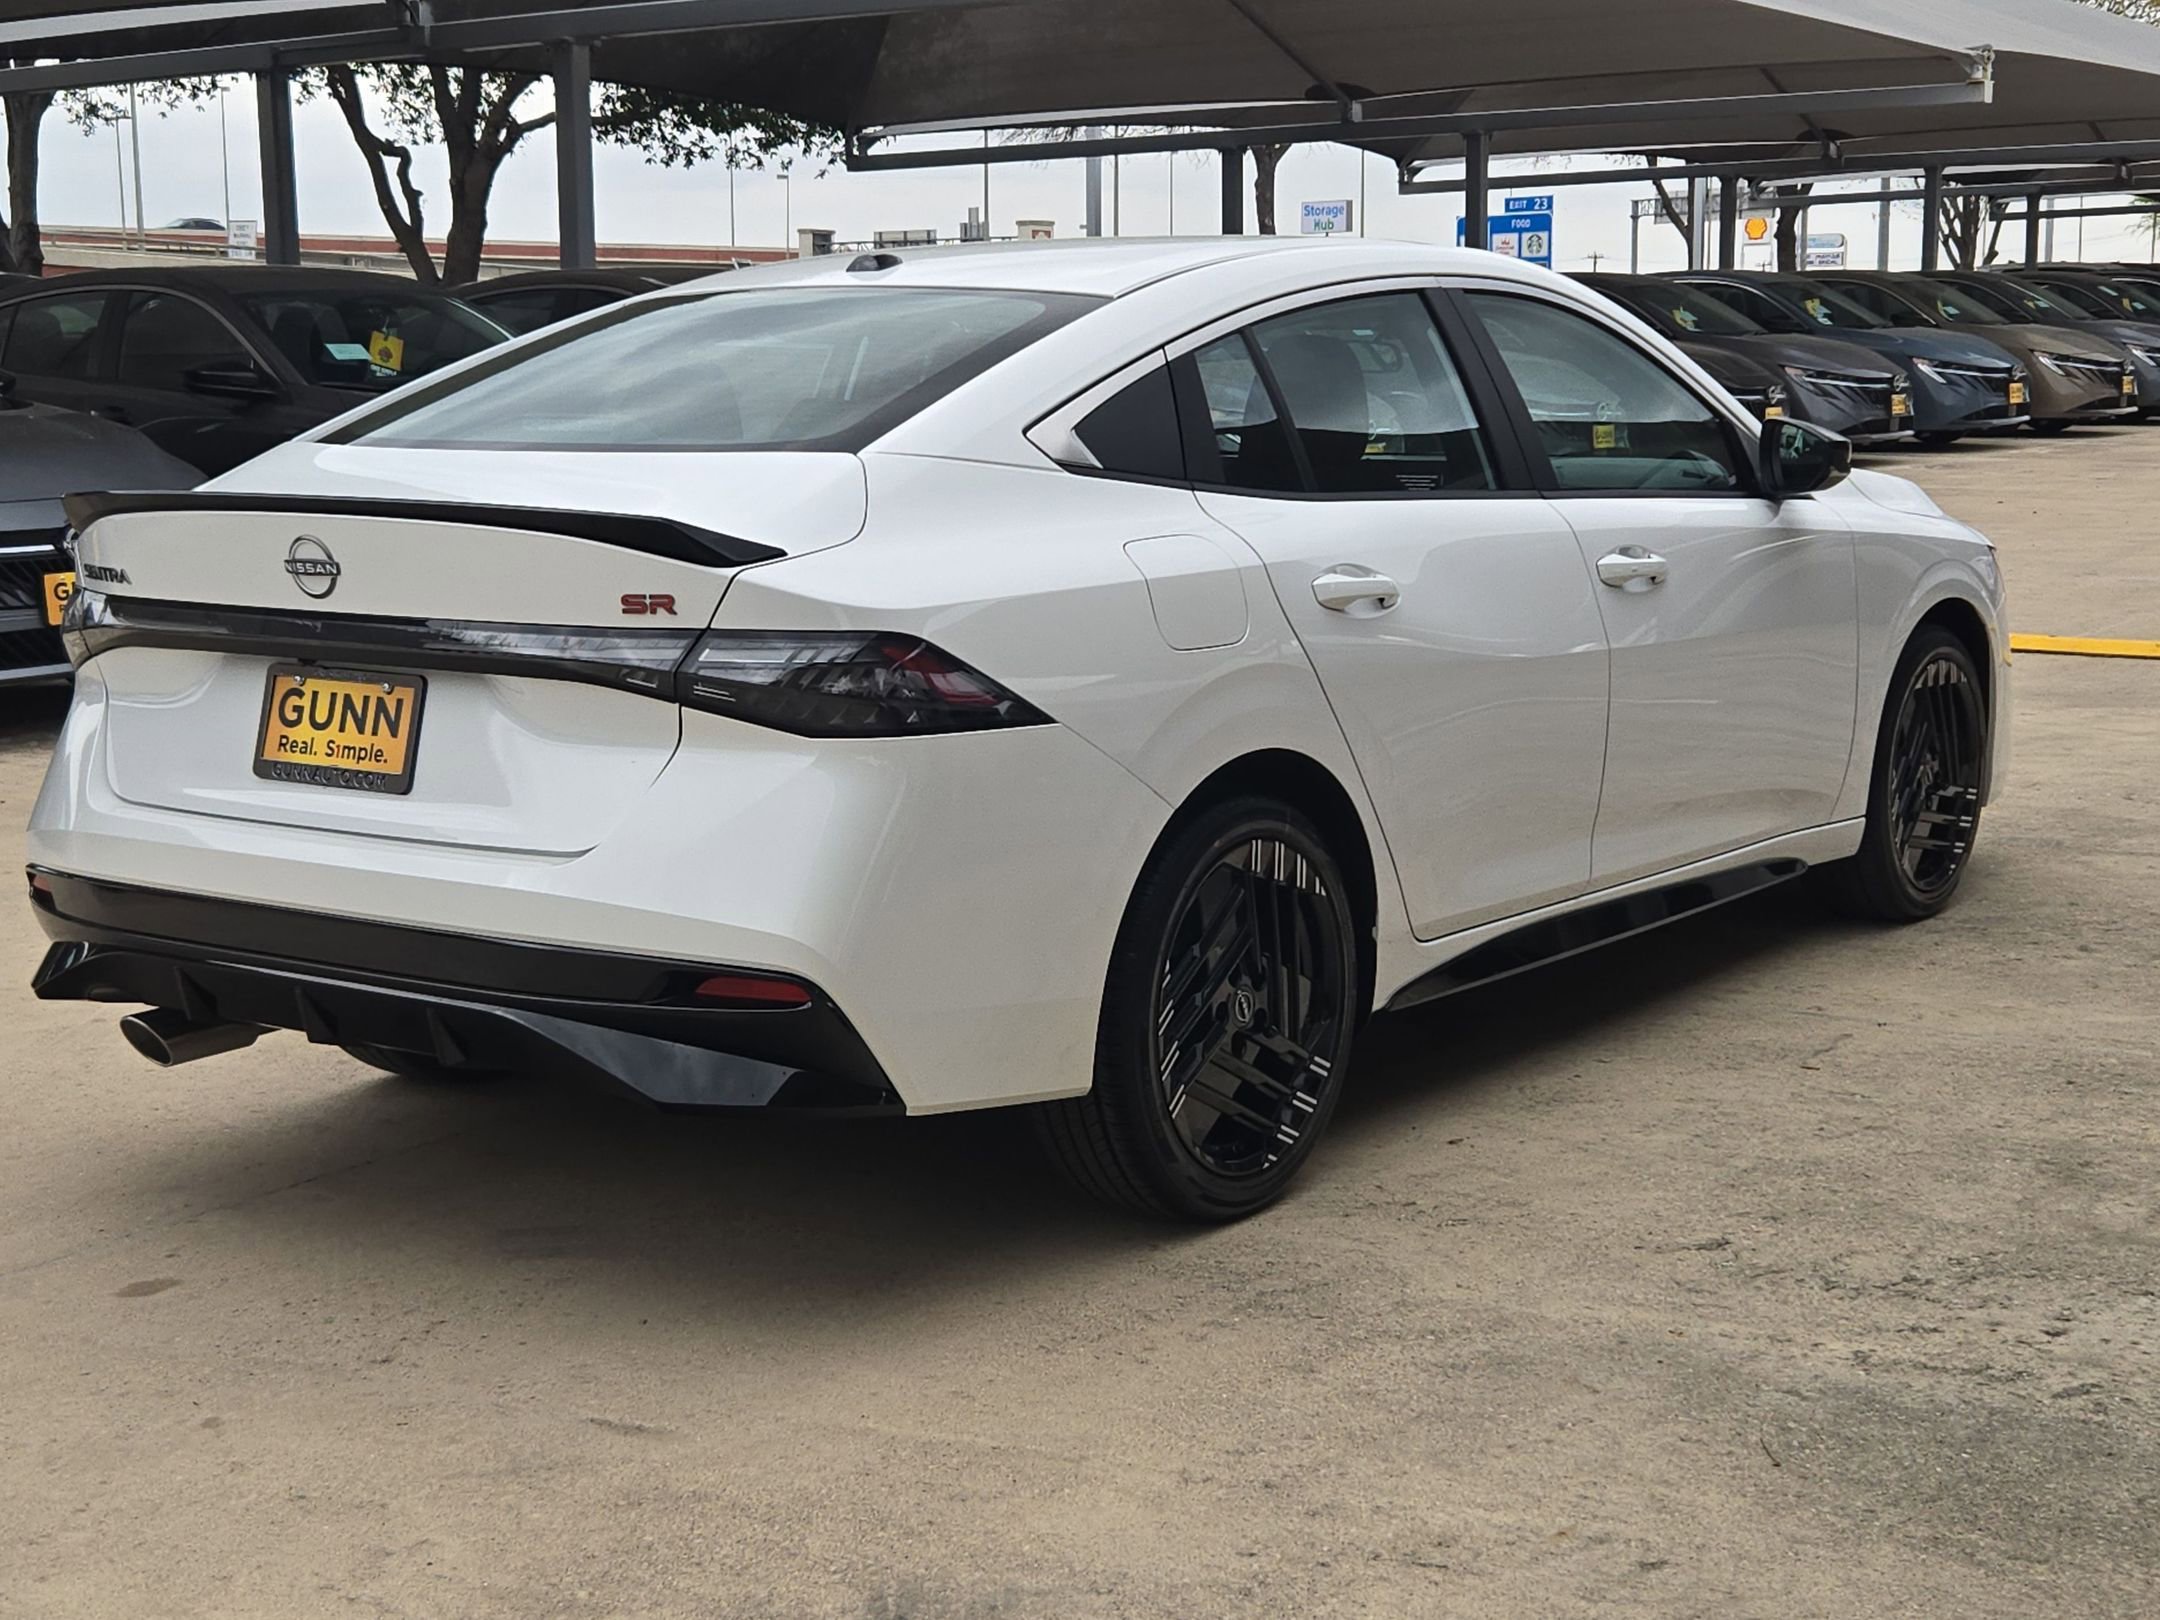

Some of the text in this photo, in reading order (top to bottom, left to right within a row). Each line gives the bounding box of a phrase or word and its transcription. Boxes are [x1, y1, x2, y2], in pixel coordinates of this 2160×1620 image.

[1303, 204, 1345, 218] Storage
[1533, 197, 1548, 210] 23
[1313, 216, 1335, 232] Hub
[1511, 218, 1532, 229] FOOD
[284, 560, 338, 575] NISSAN
[620, 593, 678, 616] SR
[278, 686, 404, 739] GUNN
[277, 734, 318, 757] Real.
